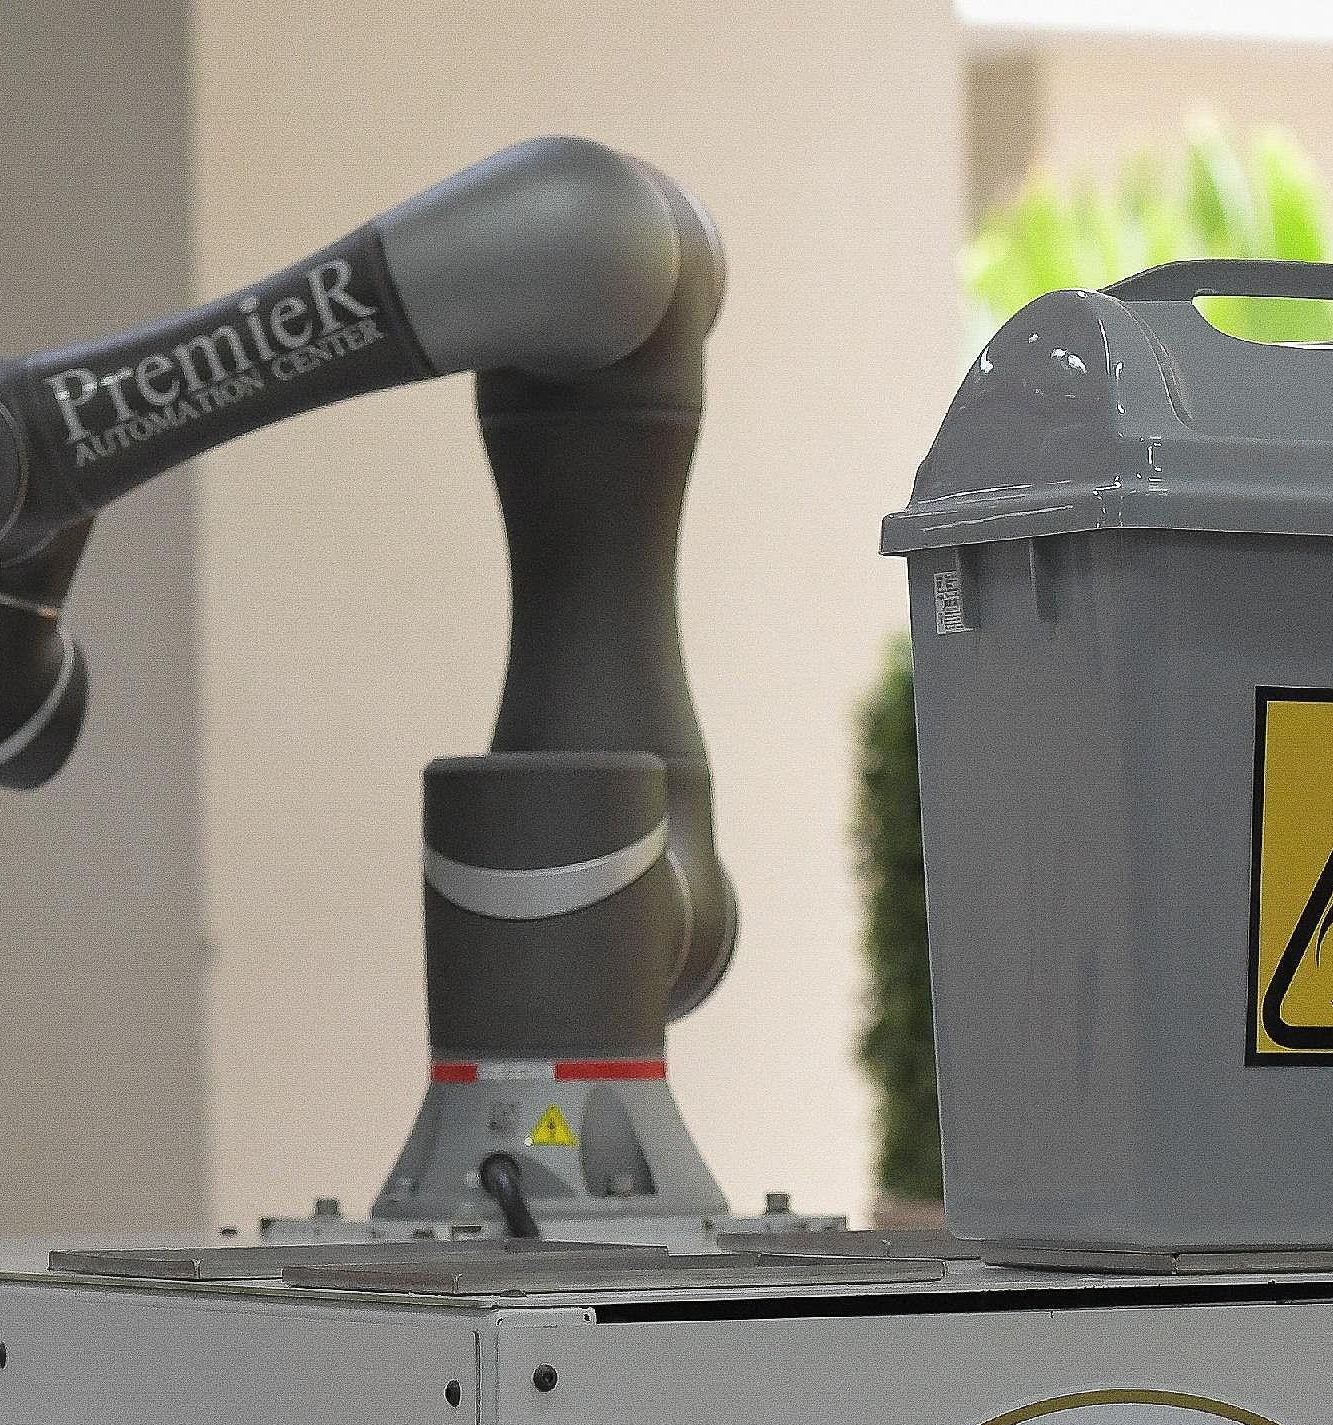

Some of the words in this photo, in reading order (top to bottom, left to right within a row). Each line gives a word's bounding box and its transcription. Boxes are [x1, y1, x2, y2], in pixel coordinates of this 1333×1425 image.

[45, 257, 377, 443] PremieR
[75, 366, 267, 468] AUTOMATION
[270, 318, 386, 382] CENTER
